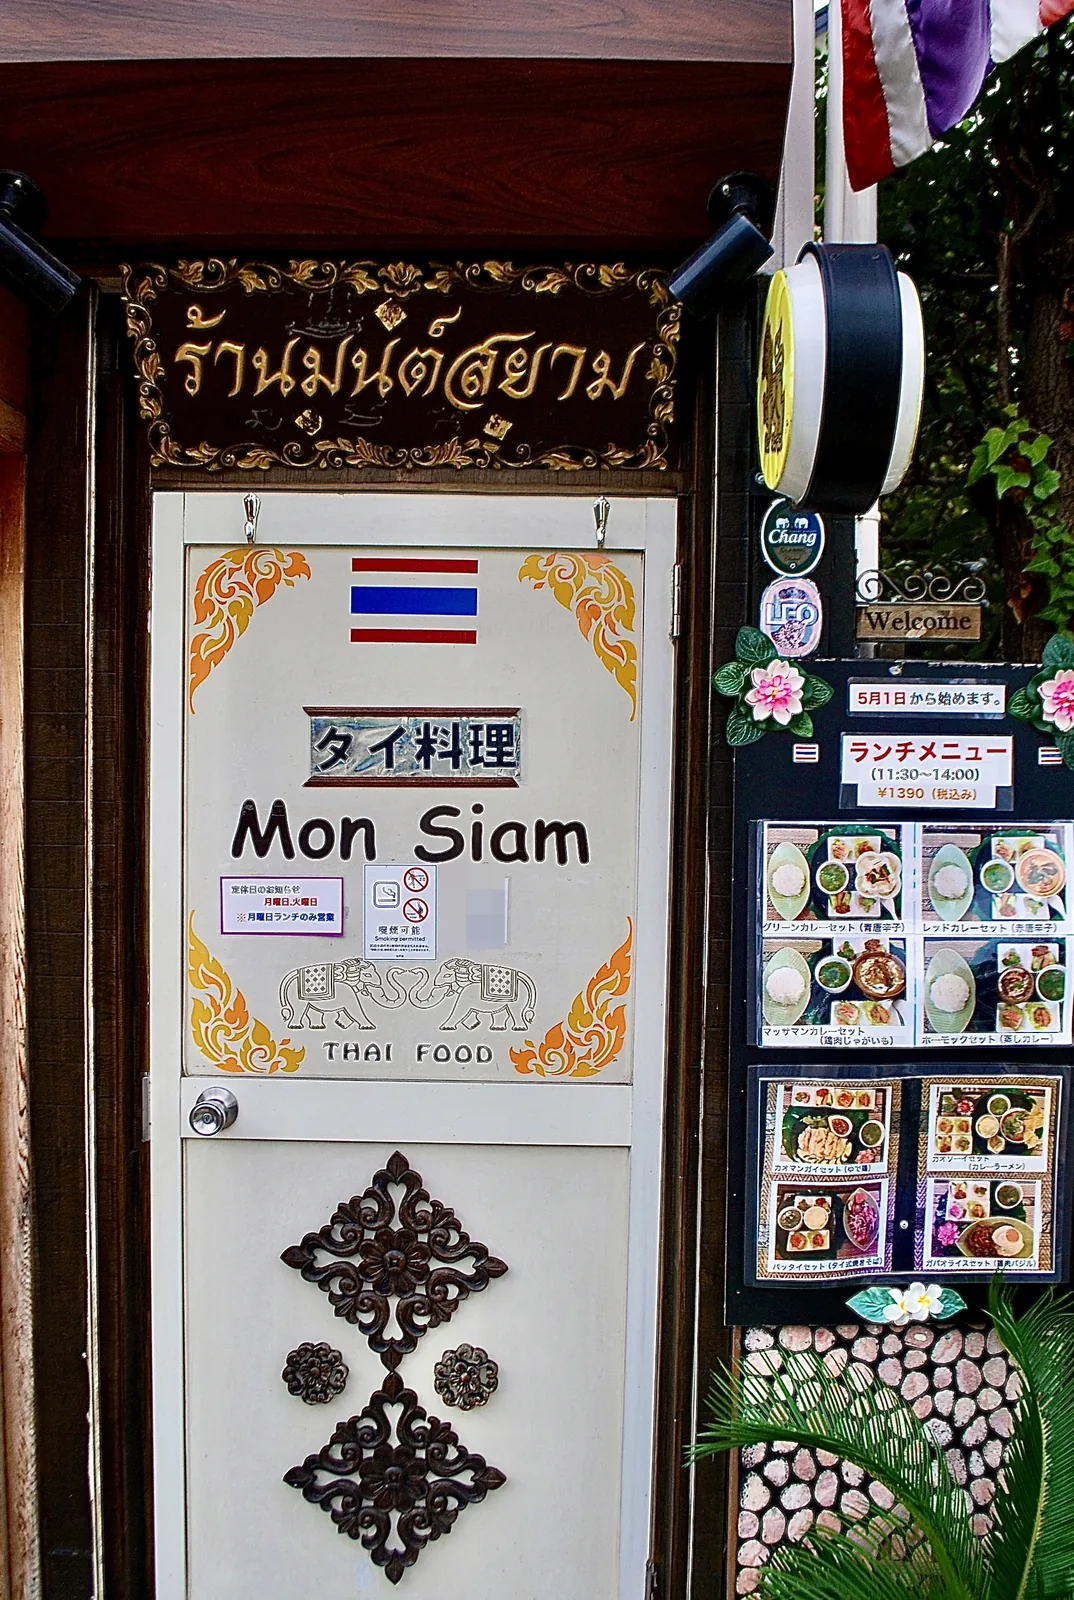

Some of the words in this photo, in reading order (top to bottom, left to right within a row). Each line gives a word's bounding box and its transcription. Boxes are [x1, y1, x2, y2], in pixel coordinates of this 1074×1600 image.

[174, 304, 646, 411] ร้านมนต์สยาม
[768, 529, 817, 547] Chang
[766, 602, 819, 626] LEO
[866, 610, 971, 631] Welcome
[314, 722, 517, 771] タイ料理
[850, 741, 1007, 763] ランチメニュー
[231, 798, 377, 861] Mon
[413, 802, 590, 866] Siam
[763, 1027, 865, 1036] マッサマンカレーセット
[323, 1041, 393, 1063] THAI
[416, 1042, 493, 1064] FOOD
